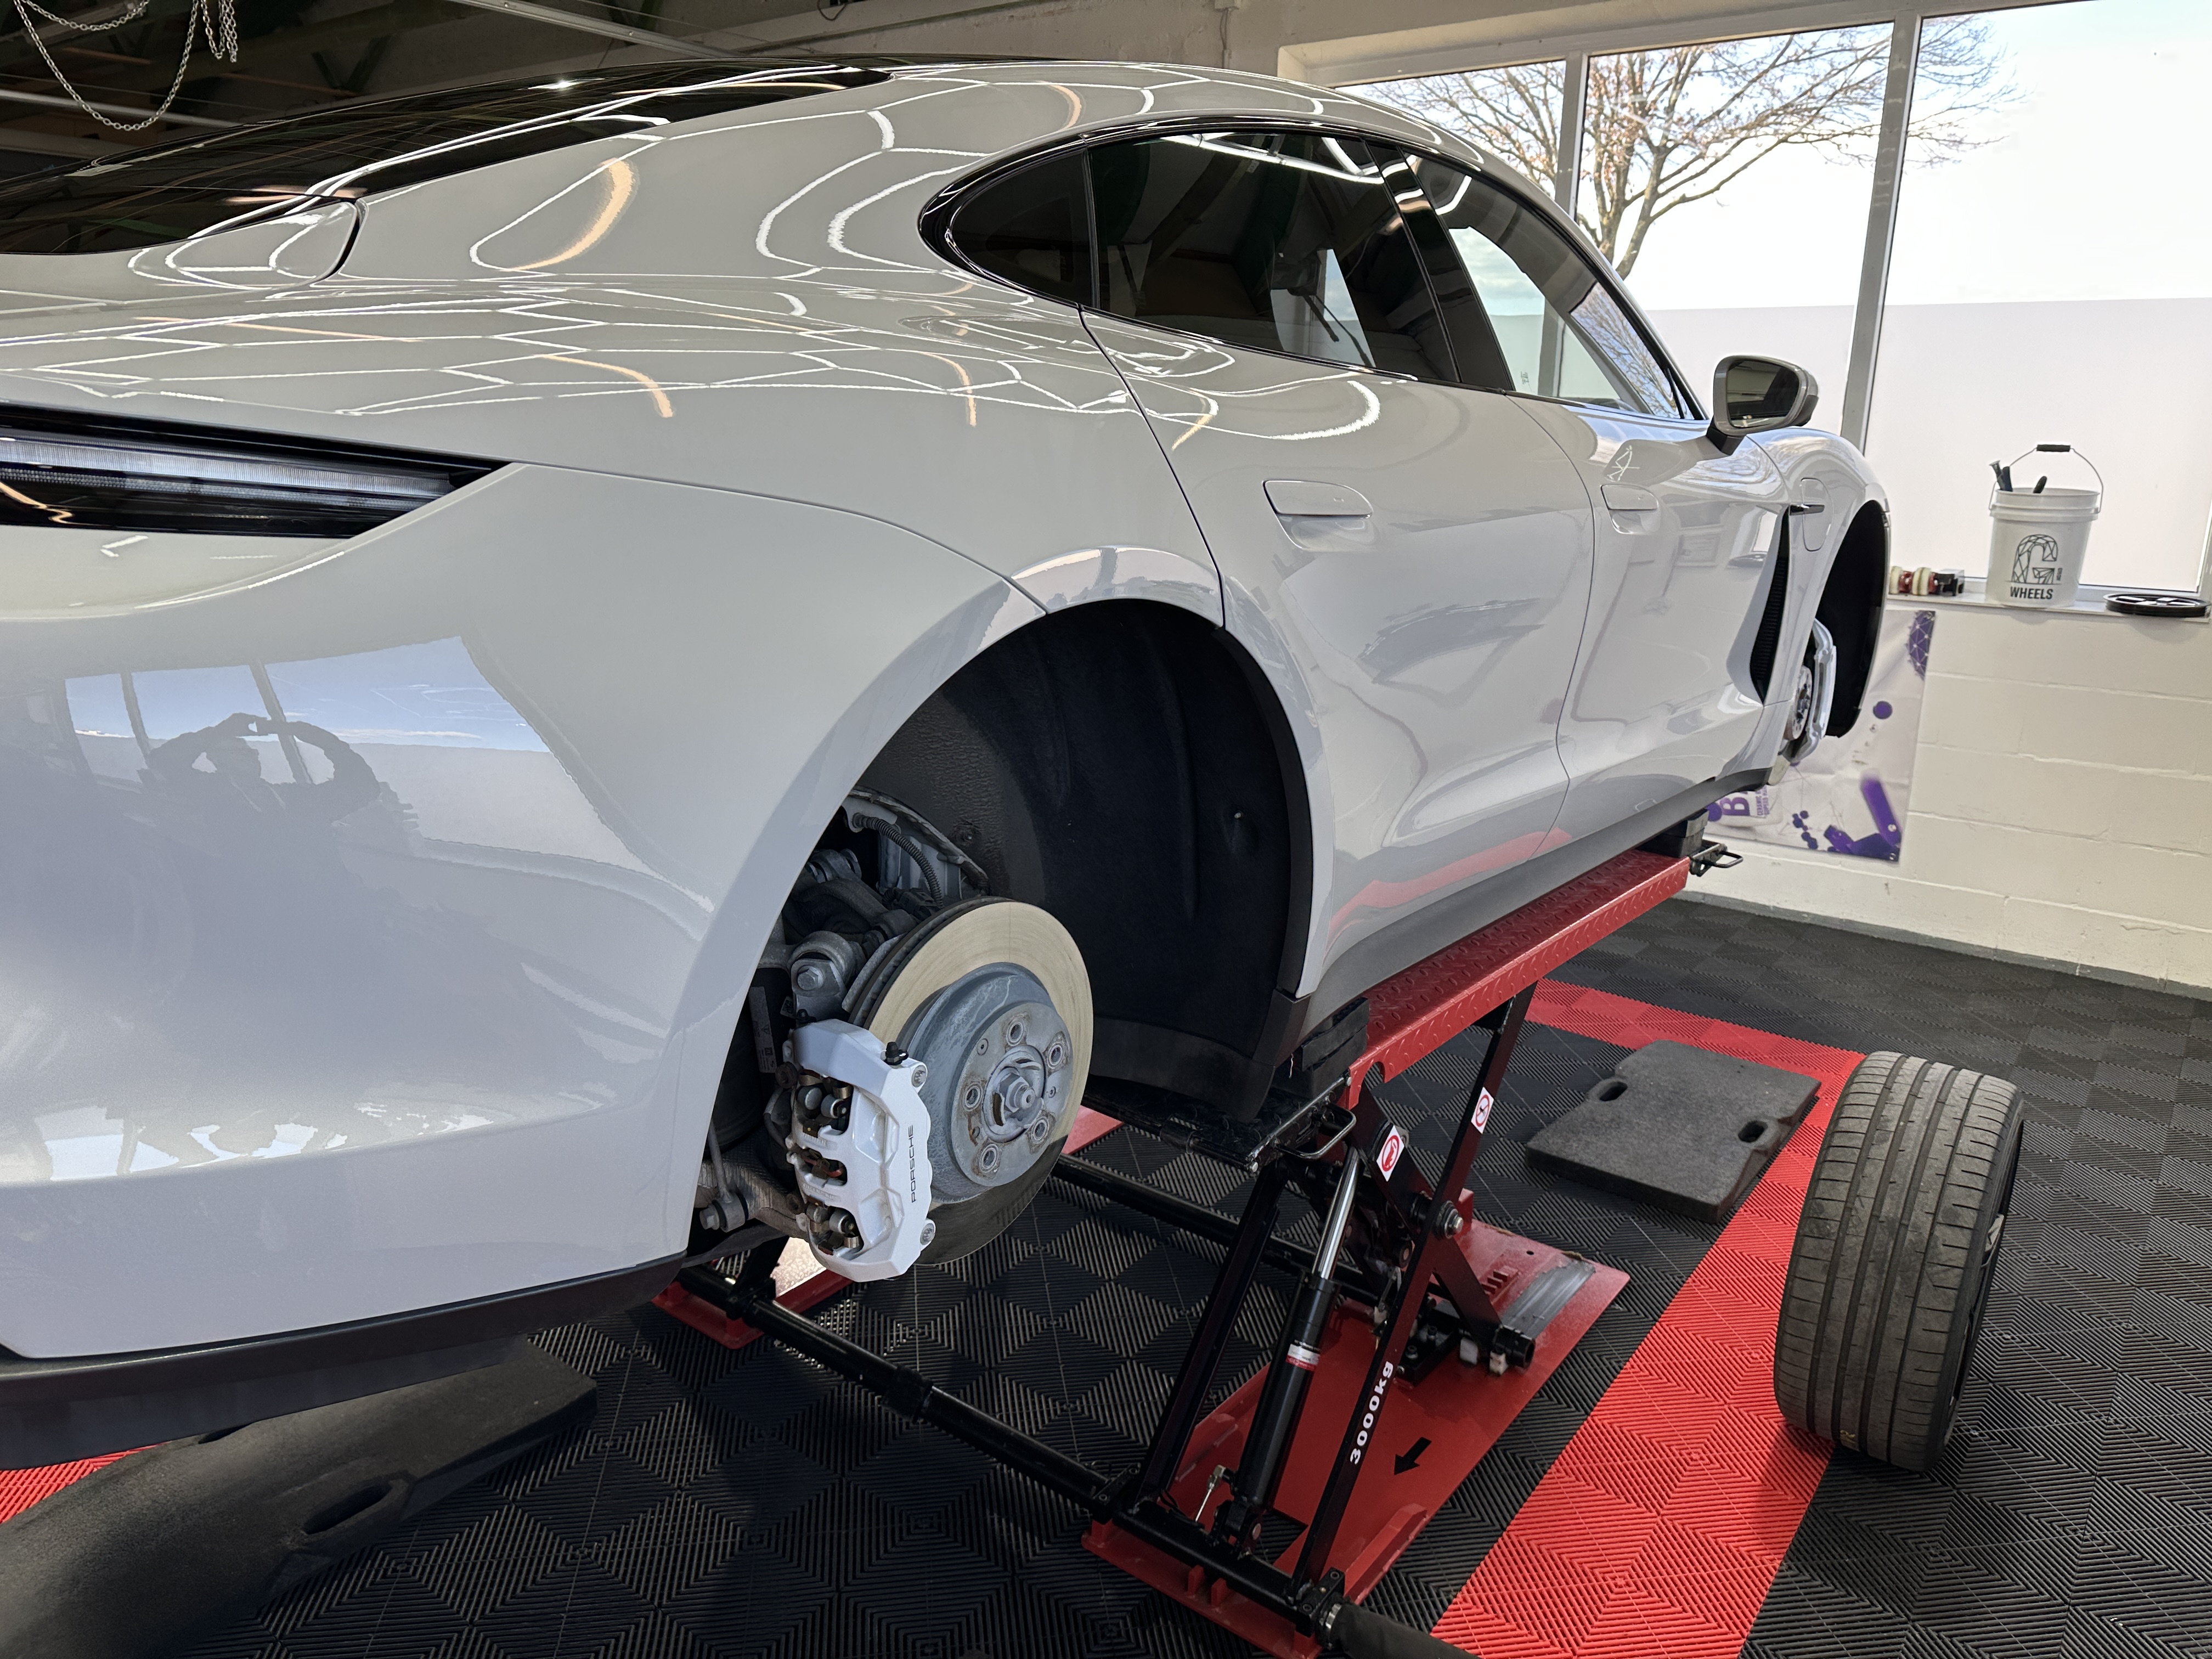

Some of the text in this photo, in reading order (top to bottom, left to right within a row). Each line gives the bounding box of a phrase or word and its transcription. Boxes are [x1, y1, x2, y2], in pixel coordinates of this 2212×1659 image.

[2010, 586, 2053, 600] WHEELS
[1719, 791, 1751, 816] B
[907, 1125, 917, 1203] PORSCHE
[1350, 1361, 1393, 1465] 3000kg
